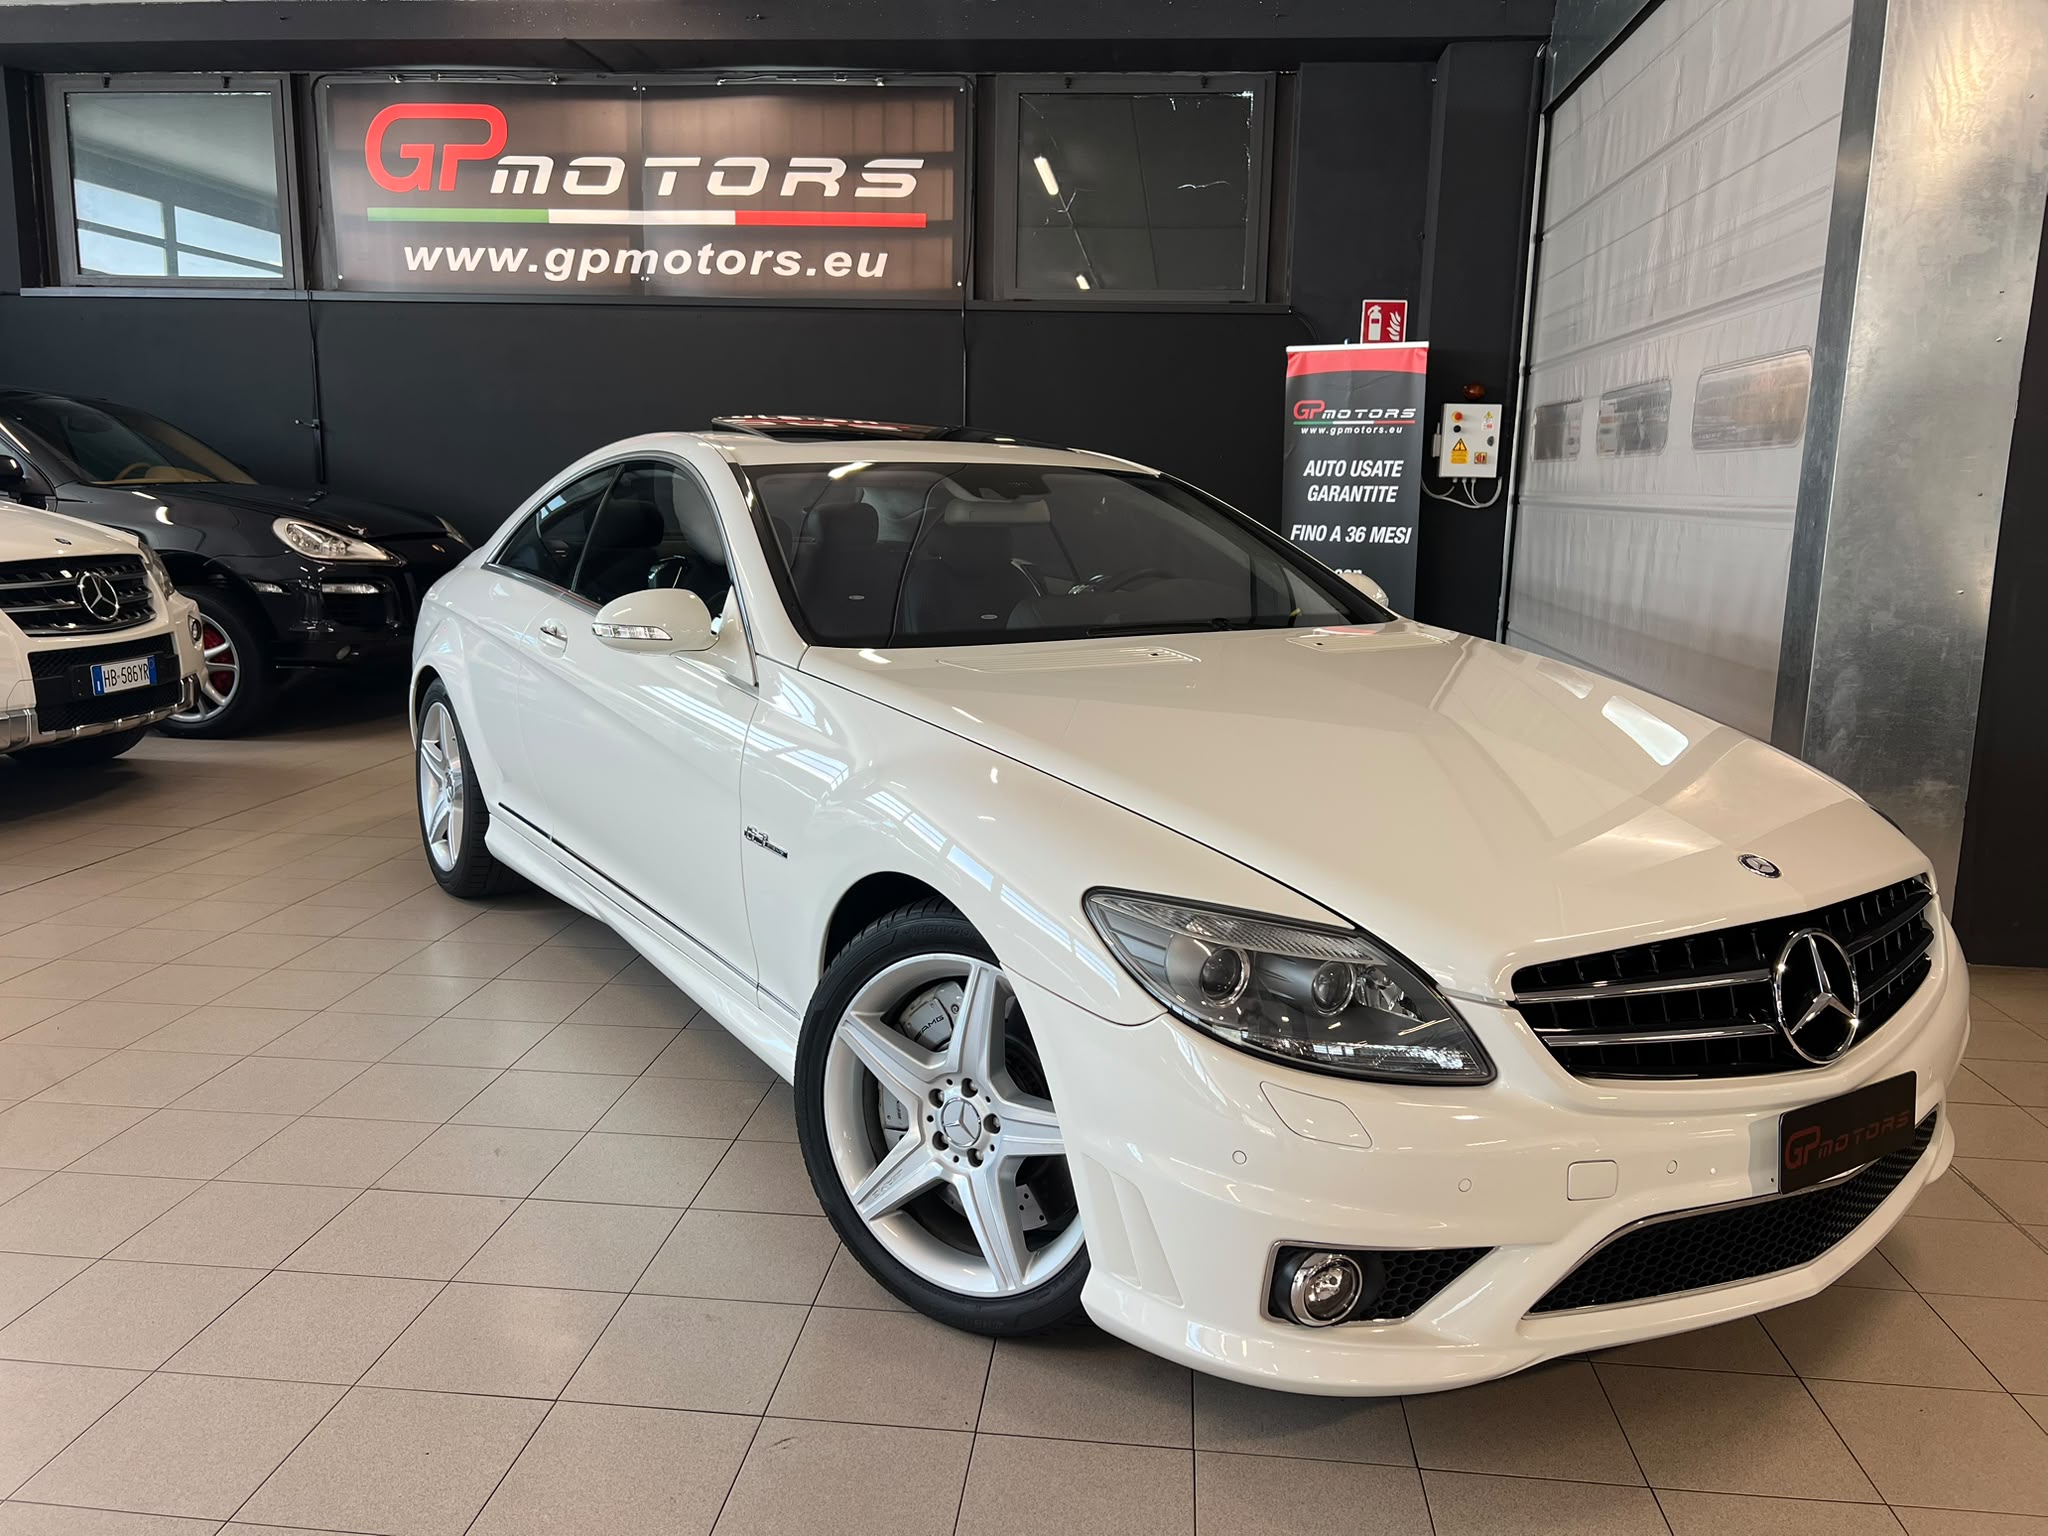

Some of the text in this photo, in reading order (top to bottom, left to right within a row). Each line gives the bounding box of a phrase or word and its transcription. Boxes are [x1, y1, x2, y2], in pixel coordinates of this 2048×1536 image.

[403, 242, 888, 281] www.gpmotors.eu
[1301, 426, 1403, 435] www.gpmotors.eu
[1303, 460, 1404, 477] AUTO USATE
[1307, 484, 1399, 502] GARANTITE
[1290, 524, 1412, 544] FINO A 36 MESI
[920, 1014, 945, 1034] AMG
